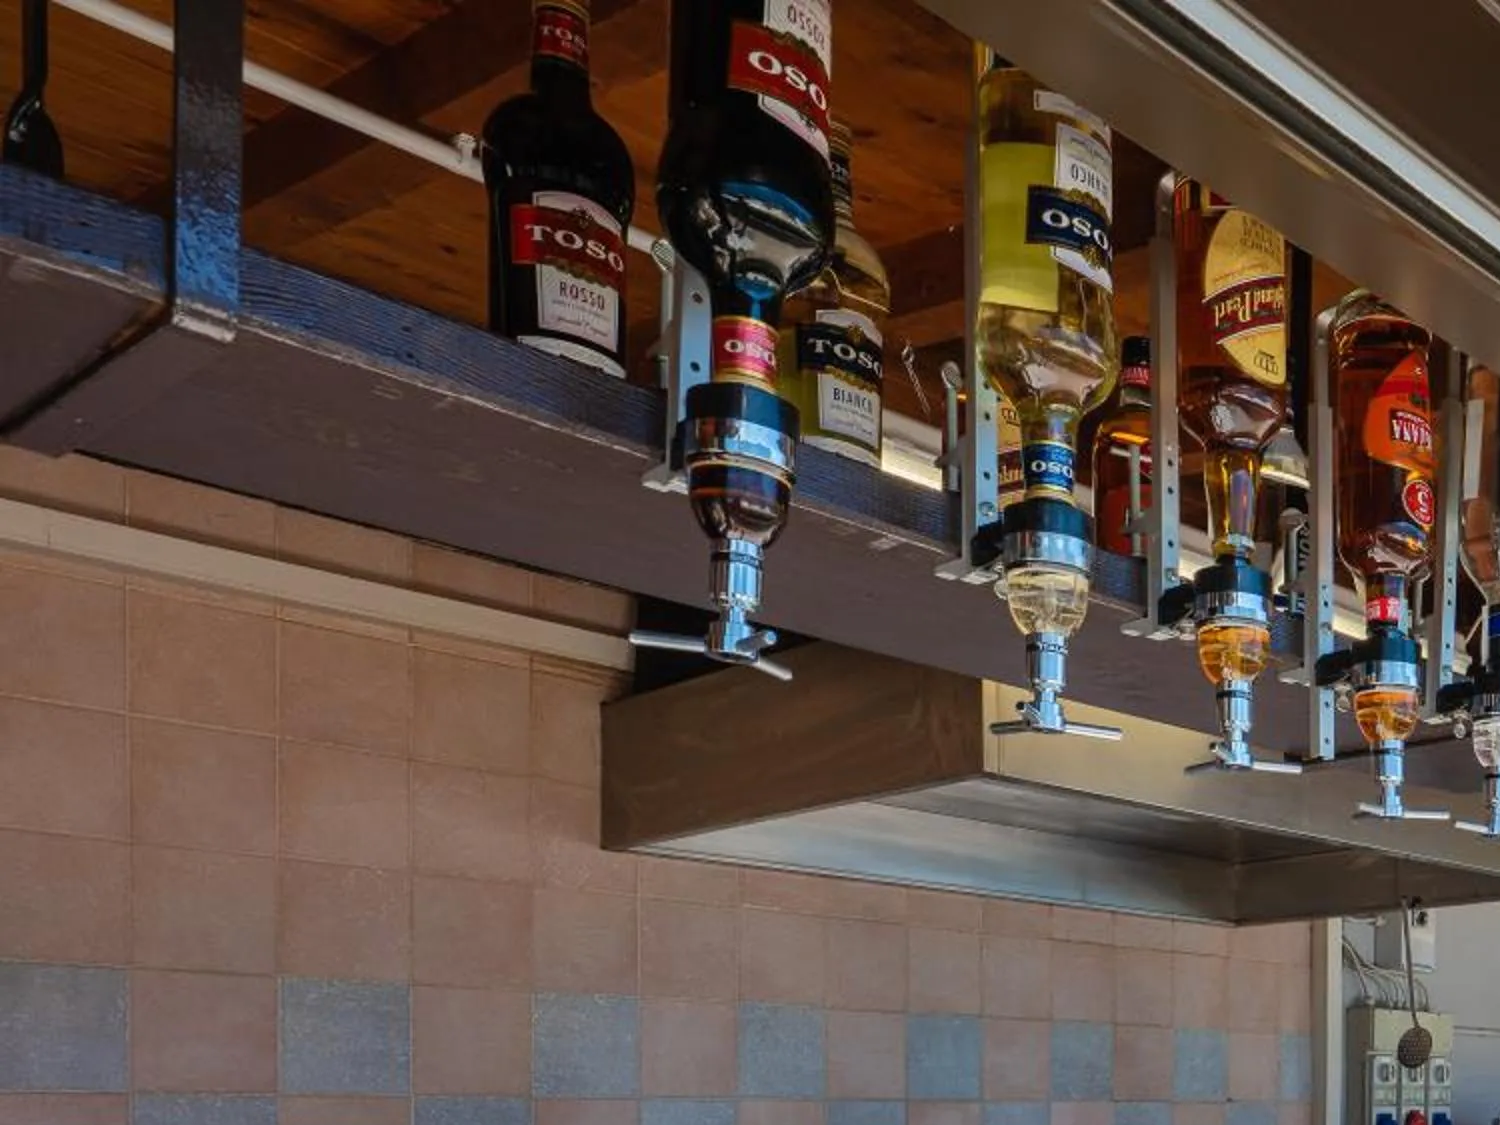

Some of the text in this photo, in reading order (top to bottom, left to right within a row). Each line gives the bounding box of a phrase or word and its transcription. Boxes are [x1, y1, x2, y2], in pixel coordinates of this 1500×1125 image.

[747, 51, 827, 111] OSO
[523, 224, 625, 273] TOSO
[1042, 208, 1109, 251] OSO
[558, 281, 606, 311] ROSSO
[1031, 459, 1073, 480] OSO
